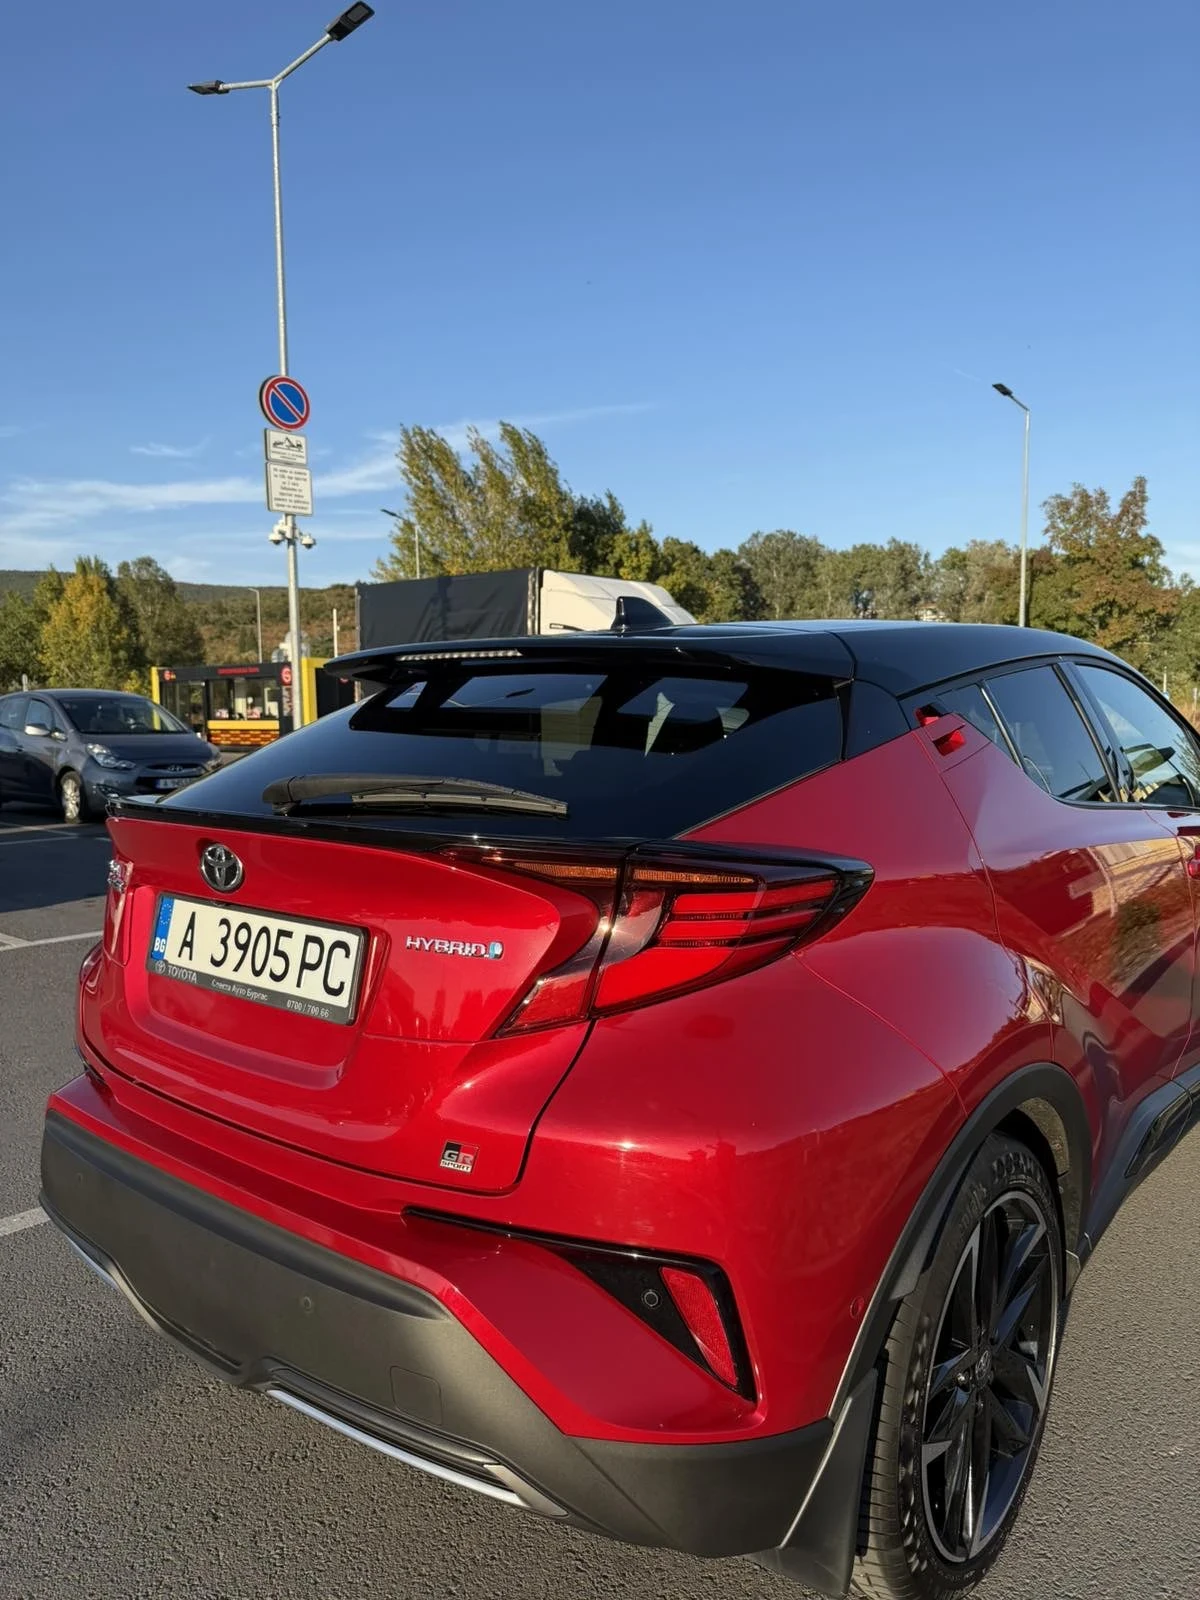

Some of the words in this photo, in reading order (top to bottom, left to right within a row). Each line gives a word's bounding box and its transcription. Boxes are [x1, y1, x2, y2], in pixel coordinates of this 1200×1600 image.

[154, 937, 166, 953] BG
[177, 911, 196, 961] A
[406, 935, 487, 957] HYBRID
[167, 963, 198, 984] TOYOTA
[441, 1160, 470, 1171] SPORT
[443, 1150, 474, 1165] GR
